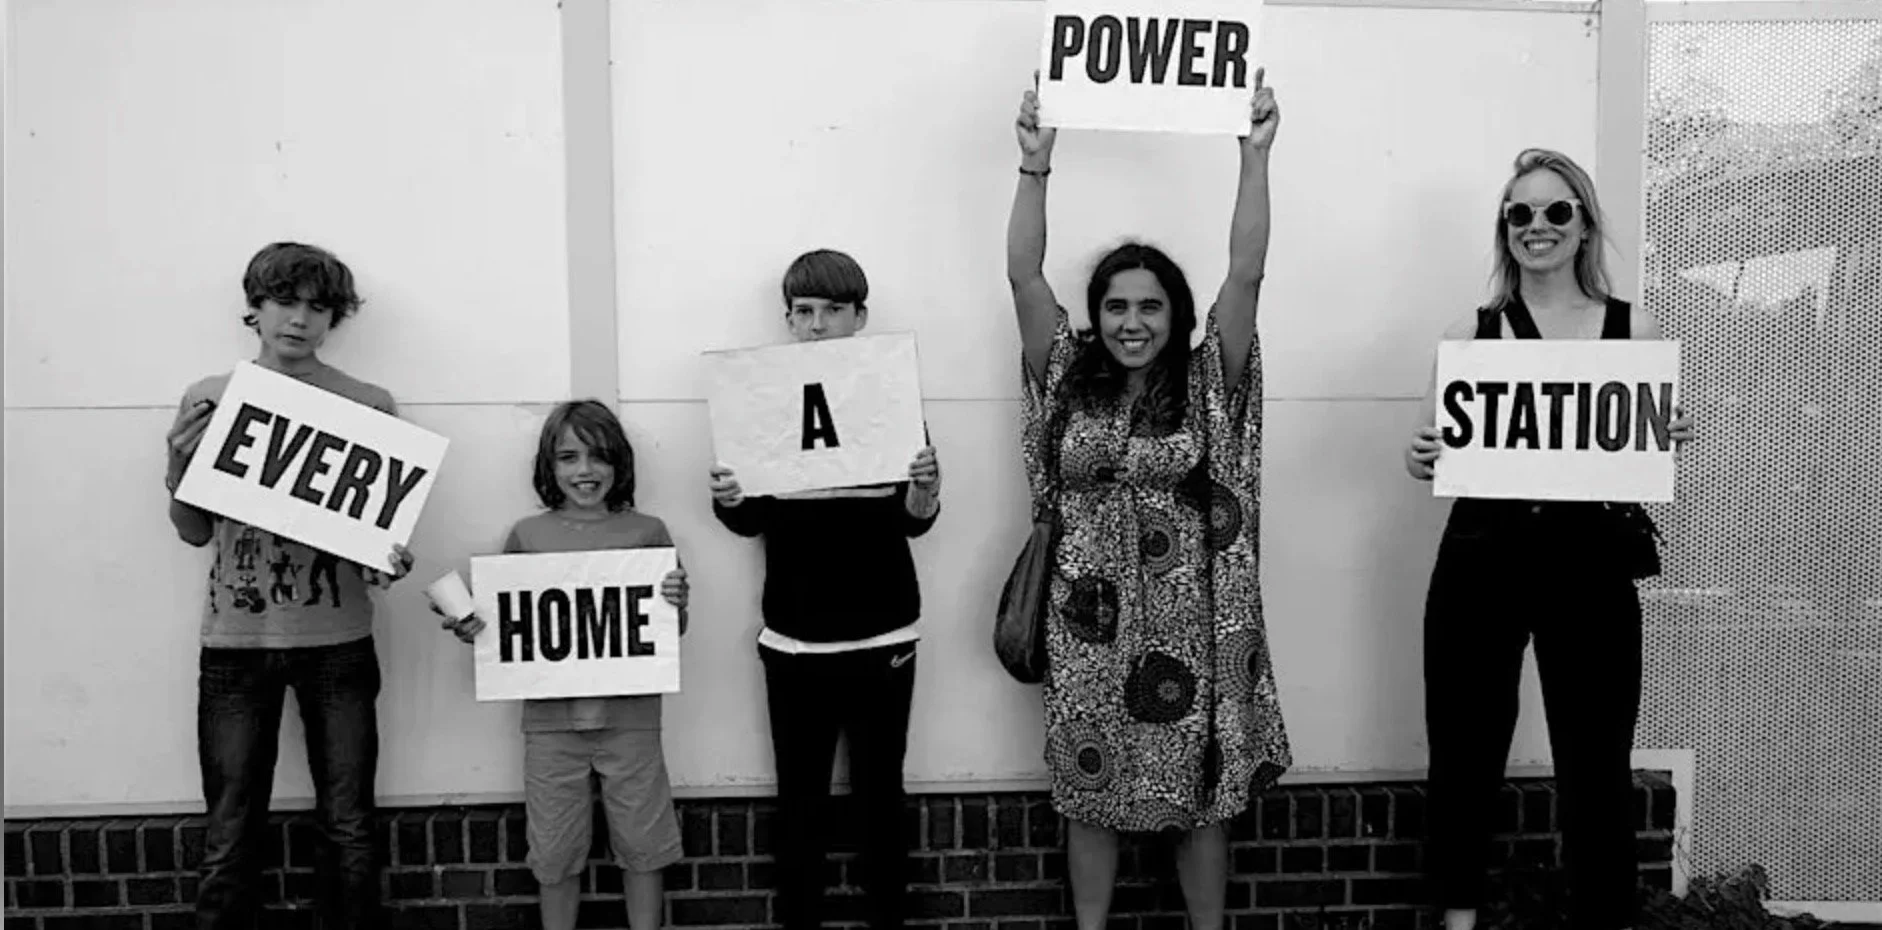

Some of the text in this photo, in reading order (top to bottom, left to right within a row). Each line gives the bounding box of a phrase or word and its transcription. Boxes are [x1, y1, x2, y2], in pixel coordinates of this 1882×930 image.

[1049, 14, 1249, 88] POWER
[800, 382, 840, 451] A
[1441, 380, 1673, 452] STATION
[213, 402, 428, 530] EVERY
[497, 584, 655, 663] HOME
